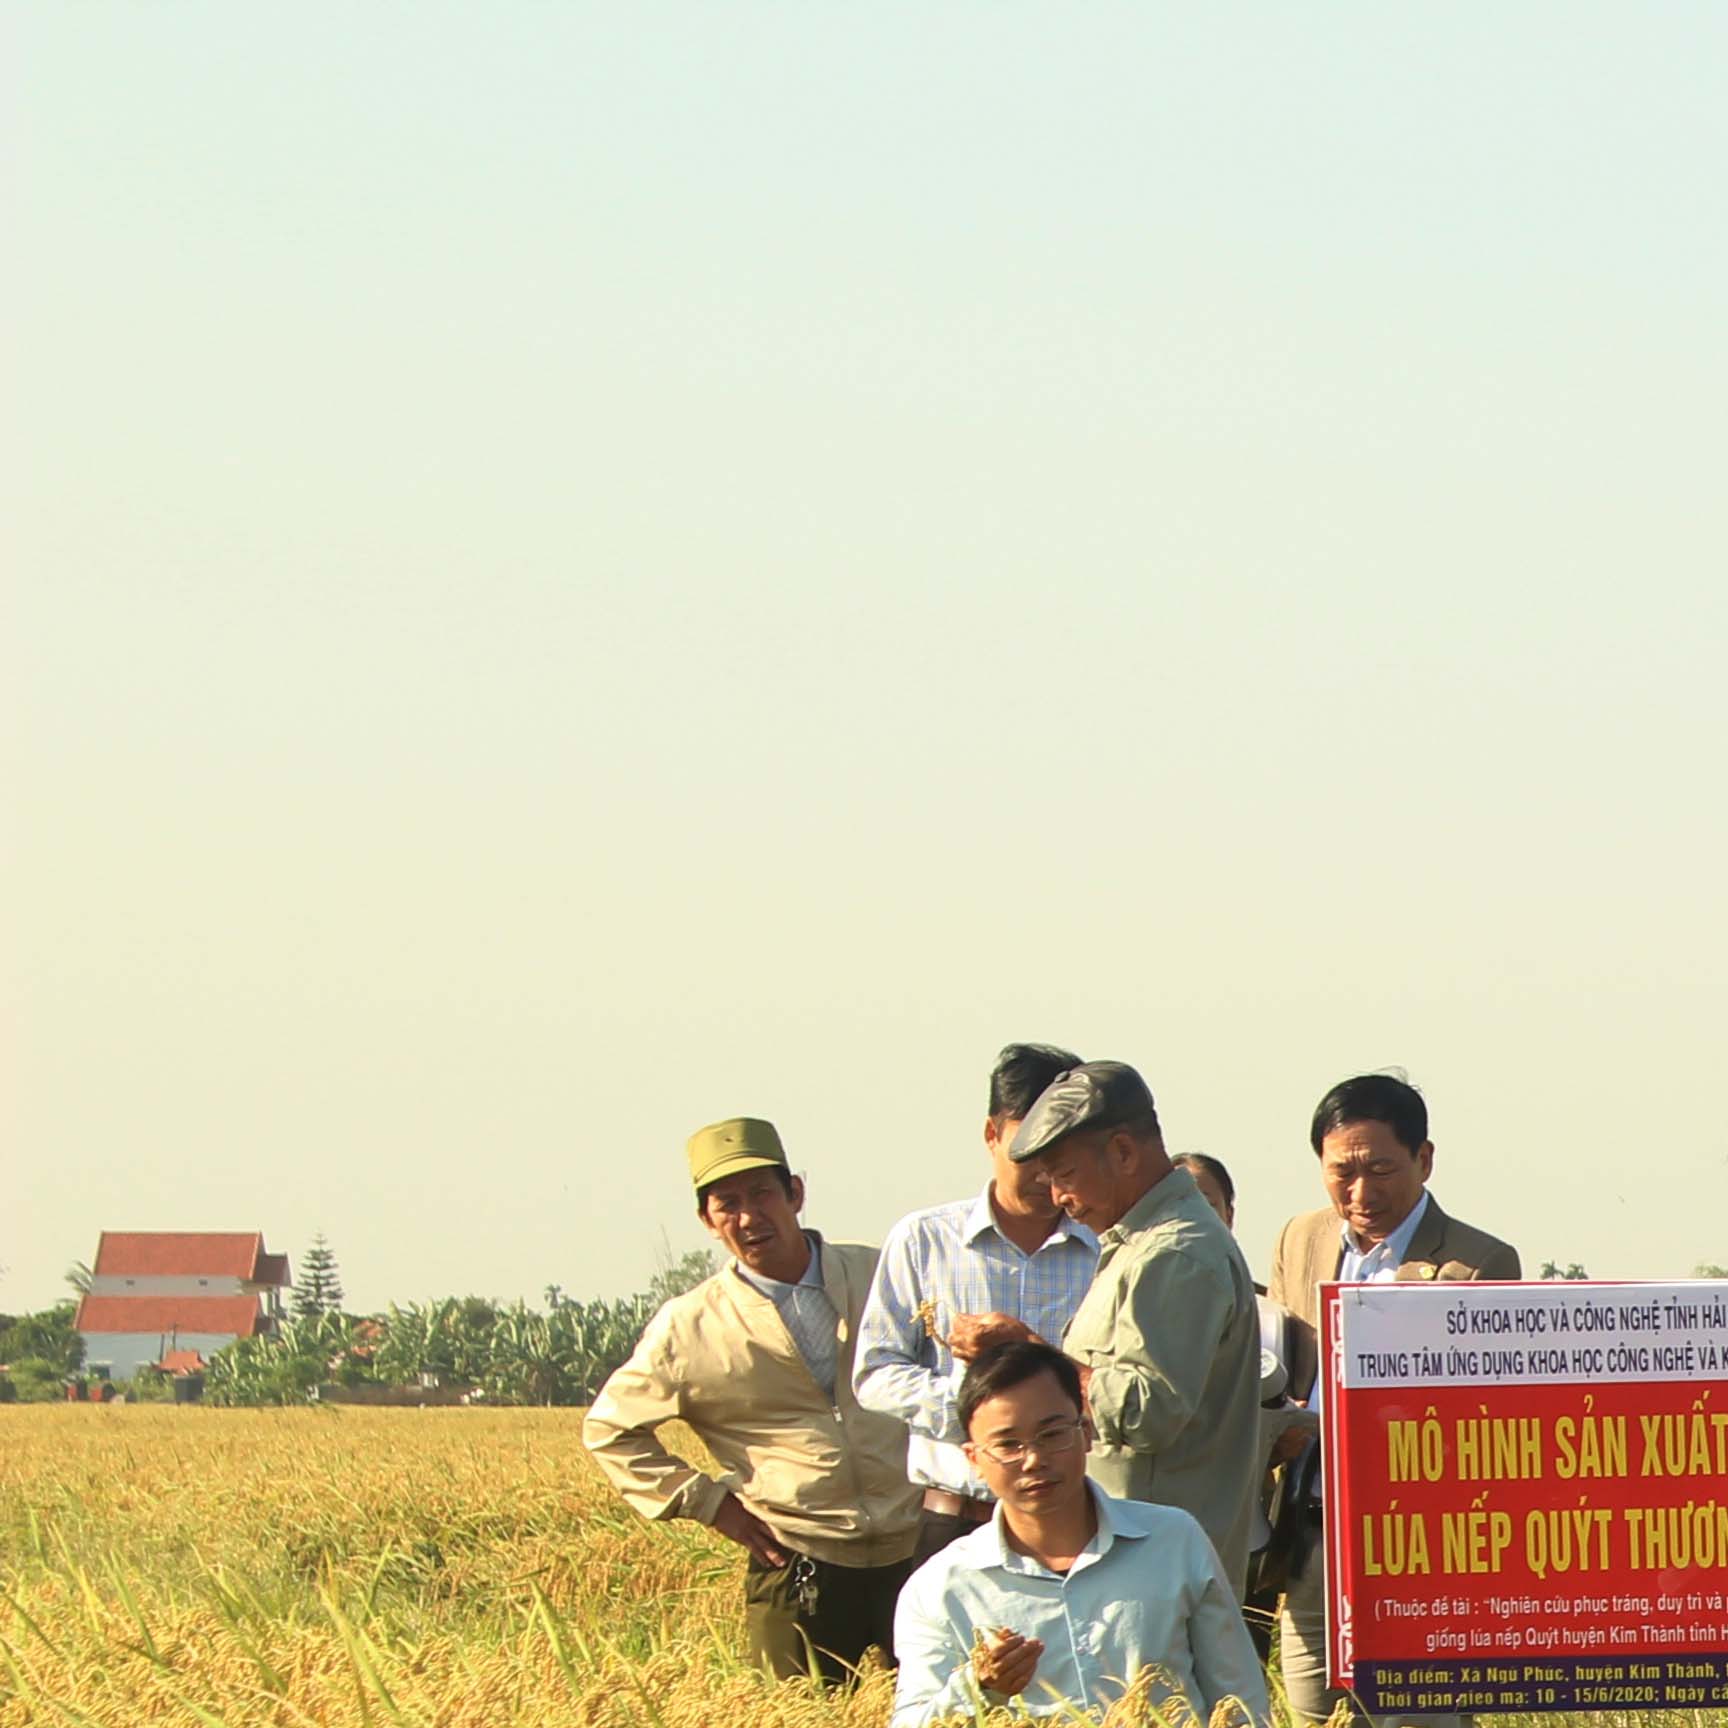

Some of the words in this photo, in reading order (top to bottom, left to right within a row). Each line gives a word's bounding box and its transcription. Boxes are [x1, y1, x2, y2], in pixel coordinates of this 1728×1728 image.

[1446, 1300, 1467, 1335] SỞ
[1471, 1308, 1512, 1333] KHOA
[1515, 1306, 1547, 1338] HỌC
[1551, 1302, 1570, 1332] VÀ
[1573, 1301, 1616, 1332] CÔNG
[1619, 1299, 1661, 1335] NGHỆ
[1664, 1296, 1698, 1330] TỈNH
[1702, 1294, 1727, 1329] HẢI
[1358, 1352, 1409, 1378] TRUNG
[1411, 1346, 1443, 1377] TÂM
[1446, 1345, 1478, 1376] ỨNG
[1482, 1349, 1524, 1380] DỤNG
[1528, 1350, 1568, 1375] KHOA
[1572, 1347, 1603, 1378] HỌC
[1606, 1342, 1650, 1373] CÔNG
[1652, 1340, 1695, 1376] NGHỆ
[1699, 1340, 1718, 1371] VÀ
[1388, 1406, 1444, 1482] MÔ
[1456, 1404, 1543, 1480] HÌNH
[1554, 1394, 1628, 1479] SẢN
[1363, 1500, 1431, 1576] LÚA
[1442, 1491, 1513, 1574] NẾP
[1525, 1496, 1613, 1579] QUÝT
[1383, 1598, 1428, 1620] Thuộc
[1452, 1597, 1470, 1616] tài
[1544, 1594, 1570, 1613] cứu
[1573, 1595, 1609, 1617] phục
[1612, 1593, 1654, 1616] tráng,
[1657, 1593, 1683, 1615] duy
[1687, 1591, 1702, 1610] trì
[1706, 1591, 1723, 1610] và
[1426, 1627, 1467, 1652] giống
[1470, 1628, 1491, 1646] lúa
[1495, 1626, 1521, 1650] nếp
[1525, 1626, 1559, 1649] Quýt
[1562, 1626, 1605, 1648] huyện
[1609, 1625, 1637, 1643] Kim
[1641, 1624, 1685, 1643] Thành
[1689, 1621, 1717, 1642] tỉnh
[1376, 1669, 1403, 1689] Địa
[1575, 1664, 1623, 1684] huyện
[1629, 1663, 1660, 1679] Kim
[1418, 1691, 1453, 1708] gian
[1459, 1689, 1494, 1708] gieo
[1500, 1691, 1529, 1708] mạ:
[1536, 1688, 1555, 1704] 10
[1574, 1684, 1660, 1704] 15/6/2020;
[1665, 1684, 1705, 1704] Ngày
